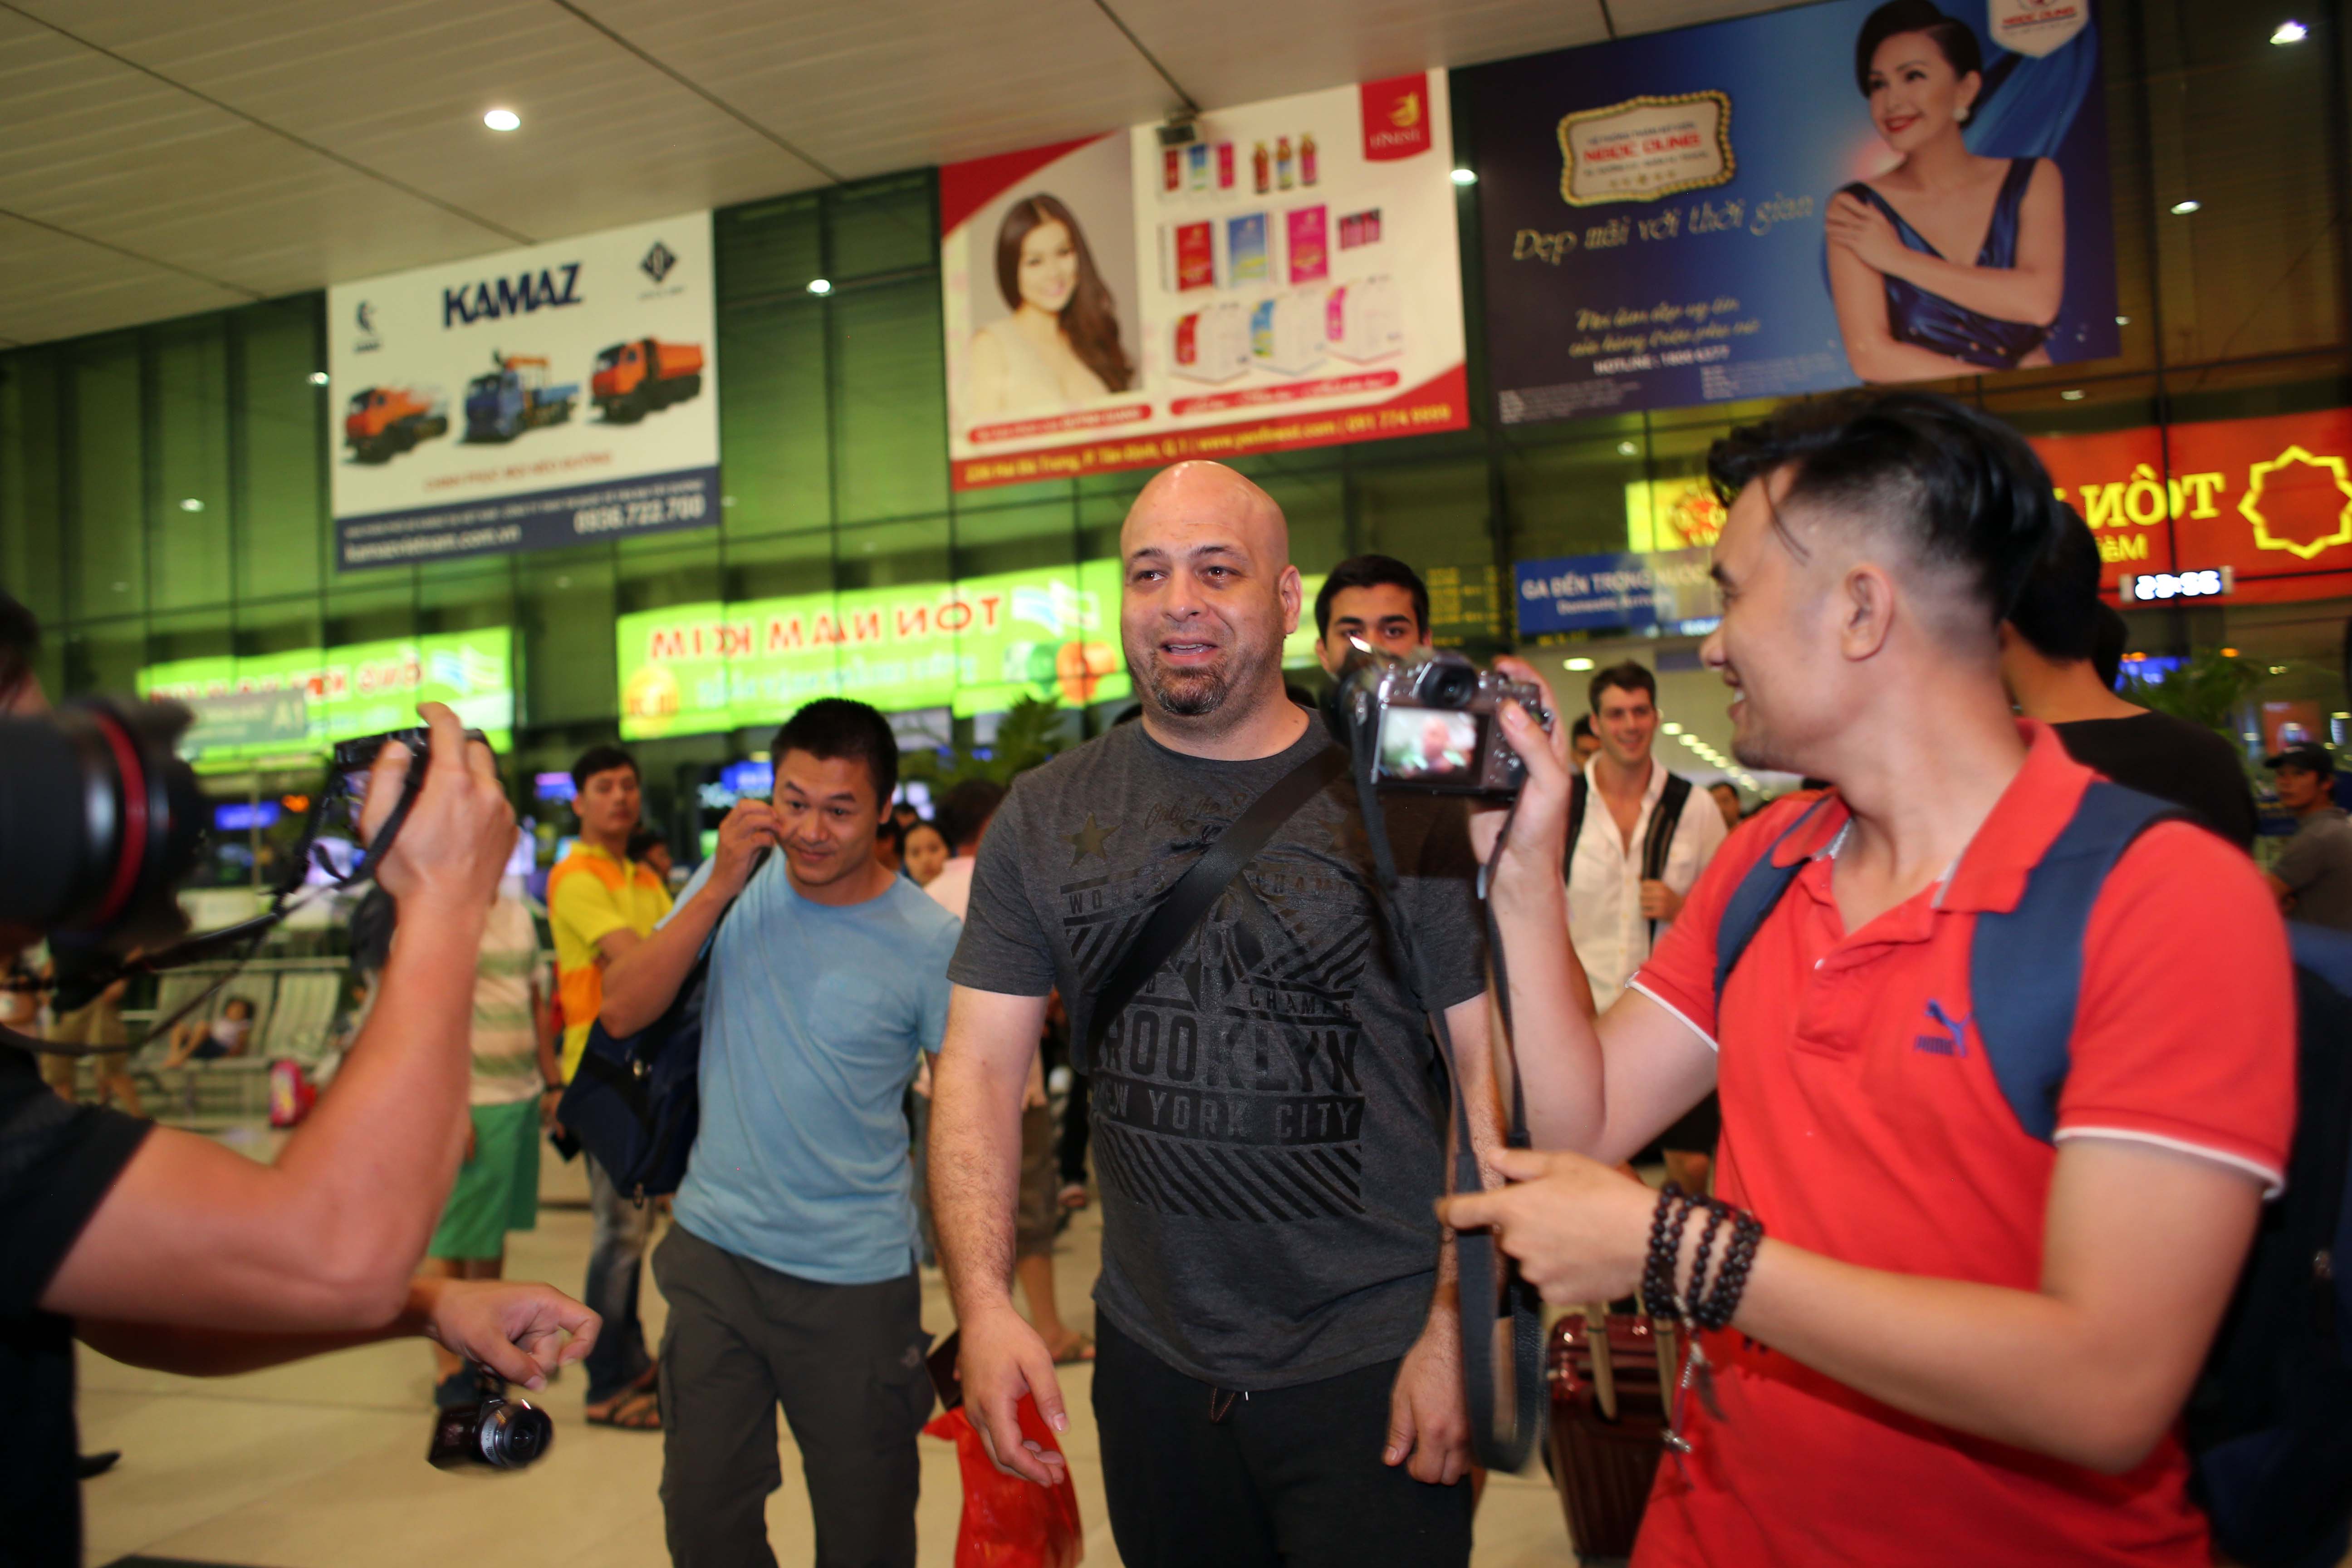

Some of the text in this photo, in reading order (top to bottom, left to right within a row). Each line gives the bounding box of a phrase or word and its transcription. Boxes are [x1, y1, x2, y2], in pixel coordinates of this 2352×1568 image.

[1750, 193, 1814, 236] gian
[442, 260, 584, 330] KAMAZ
[1521, 578, 1549, 600] GA
[1591, 569, 1653, 593] TRONG
[1101, 1009, 1361, 1093] ROOKLYN
[1148, 1089, 1247, 1137] YORK
[1275, 1101, 1354, 1138] CITY
